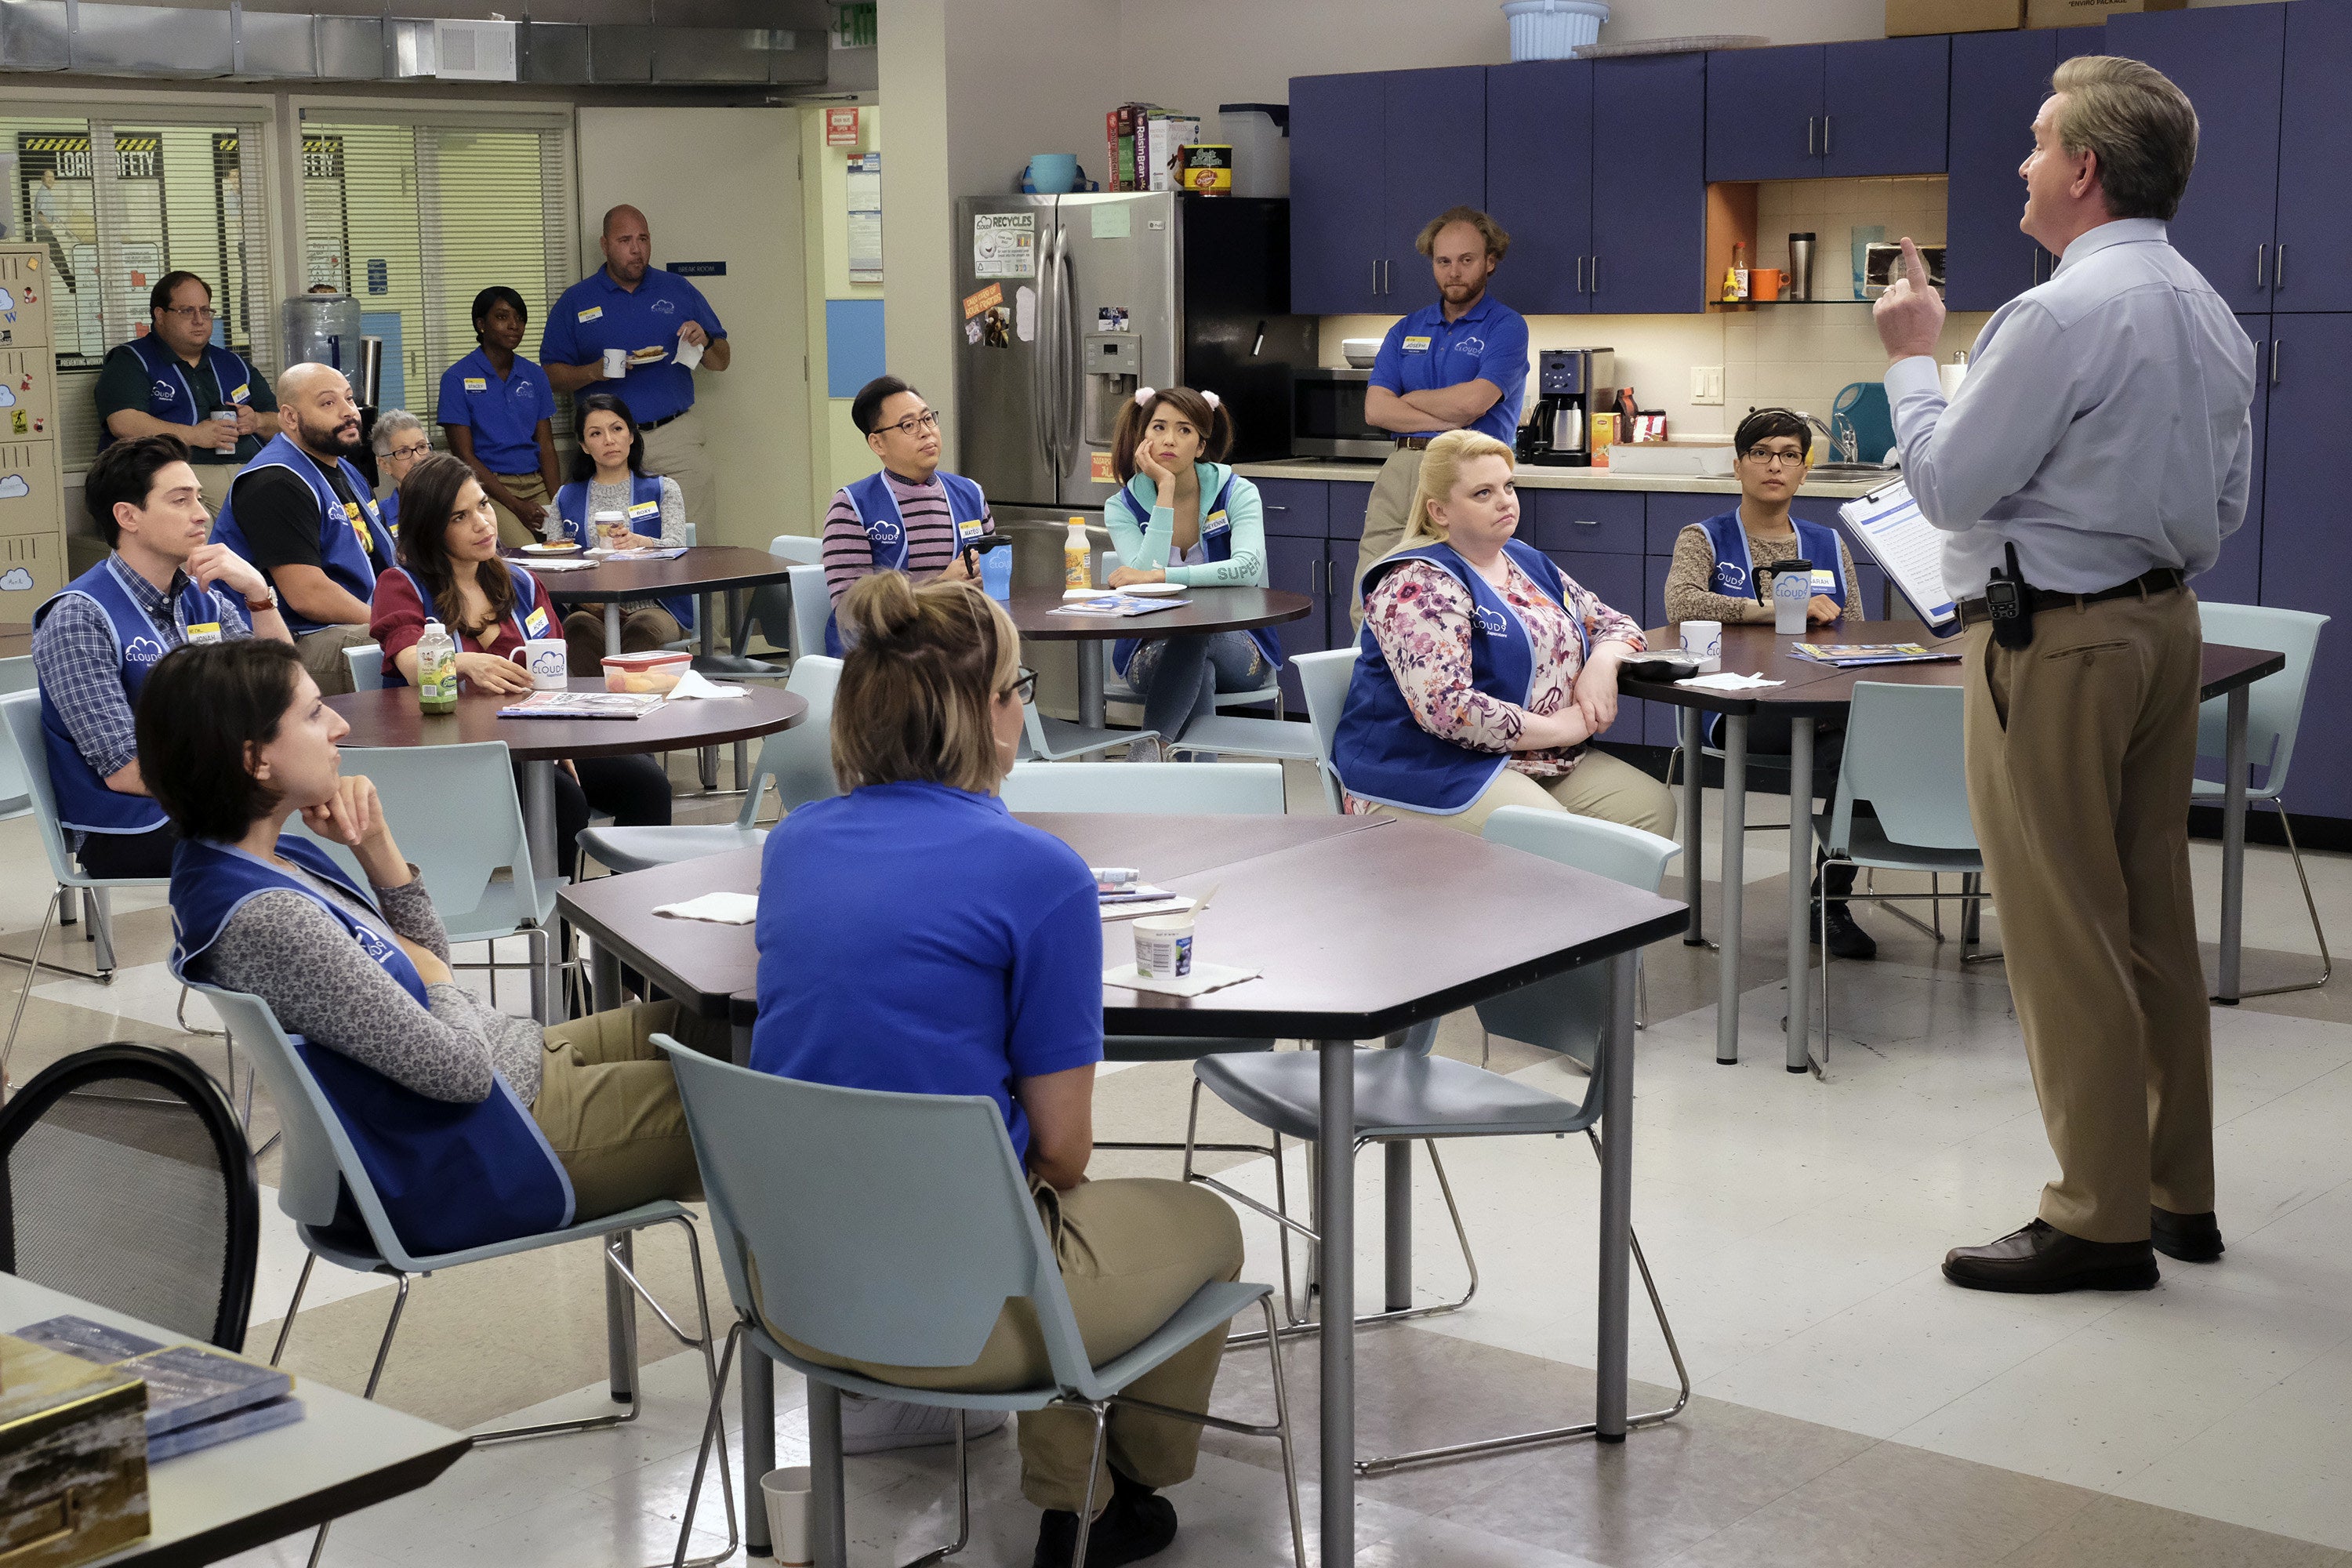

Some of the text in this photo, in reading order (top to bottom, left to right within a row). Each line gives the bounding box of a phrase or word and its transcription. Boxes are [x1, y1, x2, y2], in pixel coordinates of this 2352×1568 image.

[993, 216, 1032, 227] RECYCLES
[1203, 518, 1227, 532] CHEYENNE
[1775, 588, 1808, 598] CLOUD9
[1472, 620, 1507, 633] LOUD9
[125, 653, 162, 662] CLOUD9
[532, 664, 564, 674] CLOUD9
